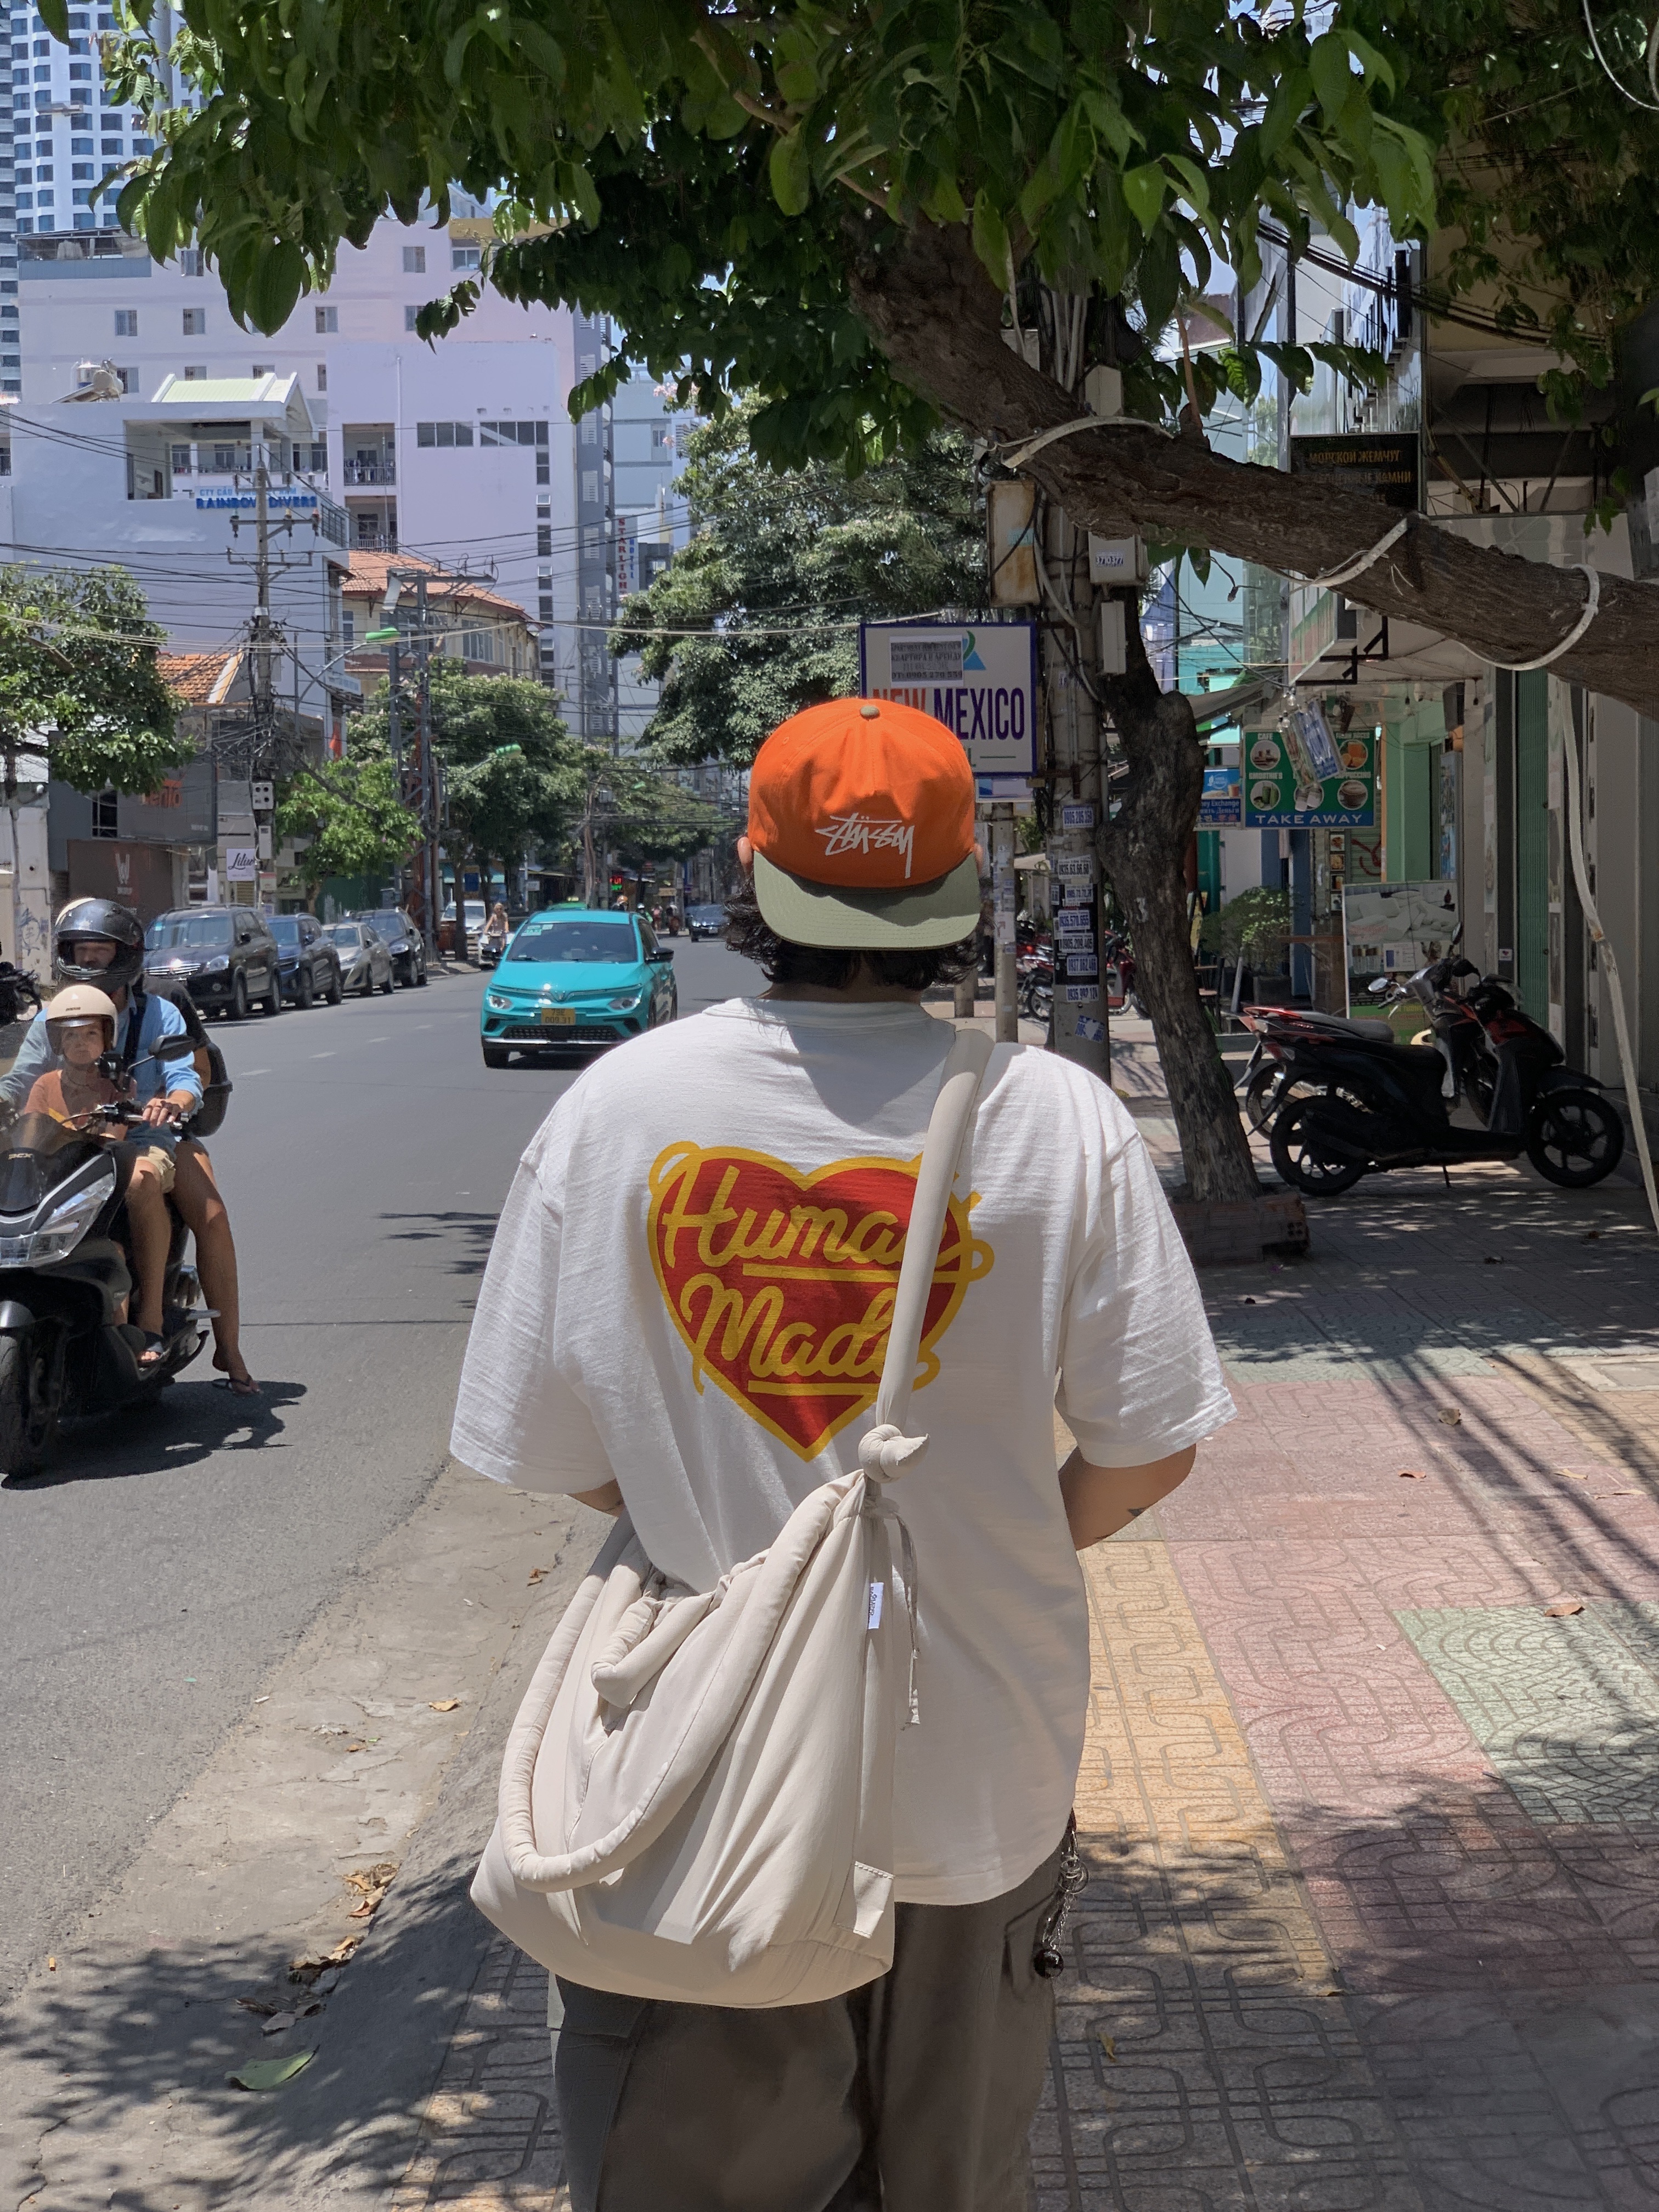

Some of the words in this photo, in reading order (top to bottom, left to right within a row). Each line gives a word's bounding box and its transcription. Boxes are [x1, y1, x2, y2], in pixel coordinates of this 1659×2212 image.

[268, 495, 317, 508] DIVERS
[934, 687, 1025, 740] MEXICO
[1255, 815, 1305, 824] TAKE
[1310, 814, 1363, 824] AWAY
[649, 1141, 952, 1268] Huma
[679, 1271, 941, 1396] Mad
